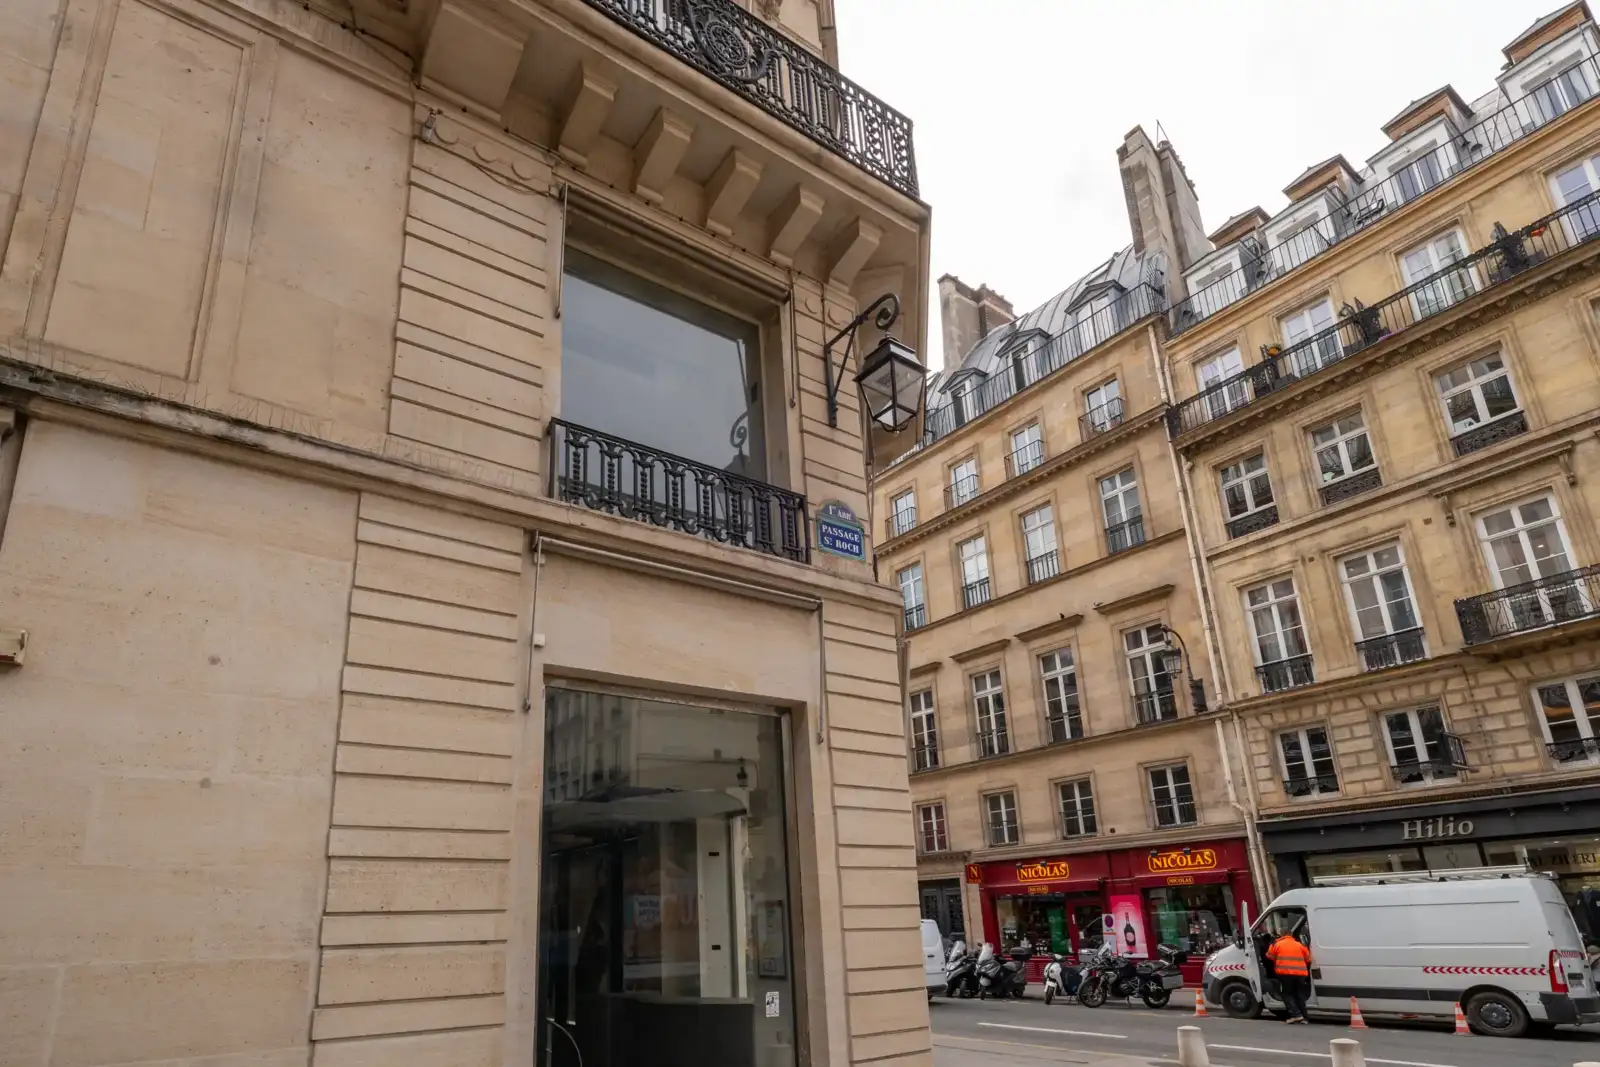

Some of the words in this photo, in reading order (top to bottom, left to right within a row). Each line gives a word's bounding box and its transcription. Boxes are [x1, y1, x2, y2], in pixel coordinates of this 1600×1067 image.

[822, 524, 860, 543] PASSAGE
[835, 539, 859, 553] ROCH
[1401, 816, 1474, 840] Hilio
[1152, 850, 1212, 869] NICOLAS
[970, 866, 979, 878] N
[1019, 865, 1067, 879] NICOLAS
